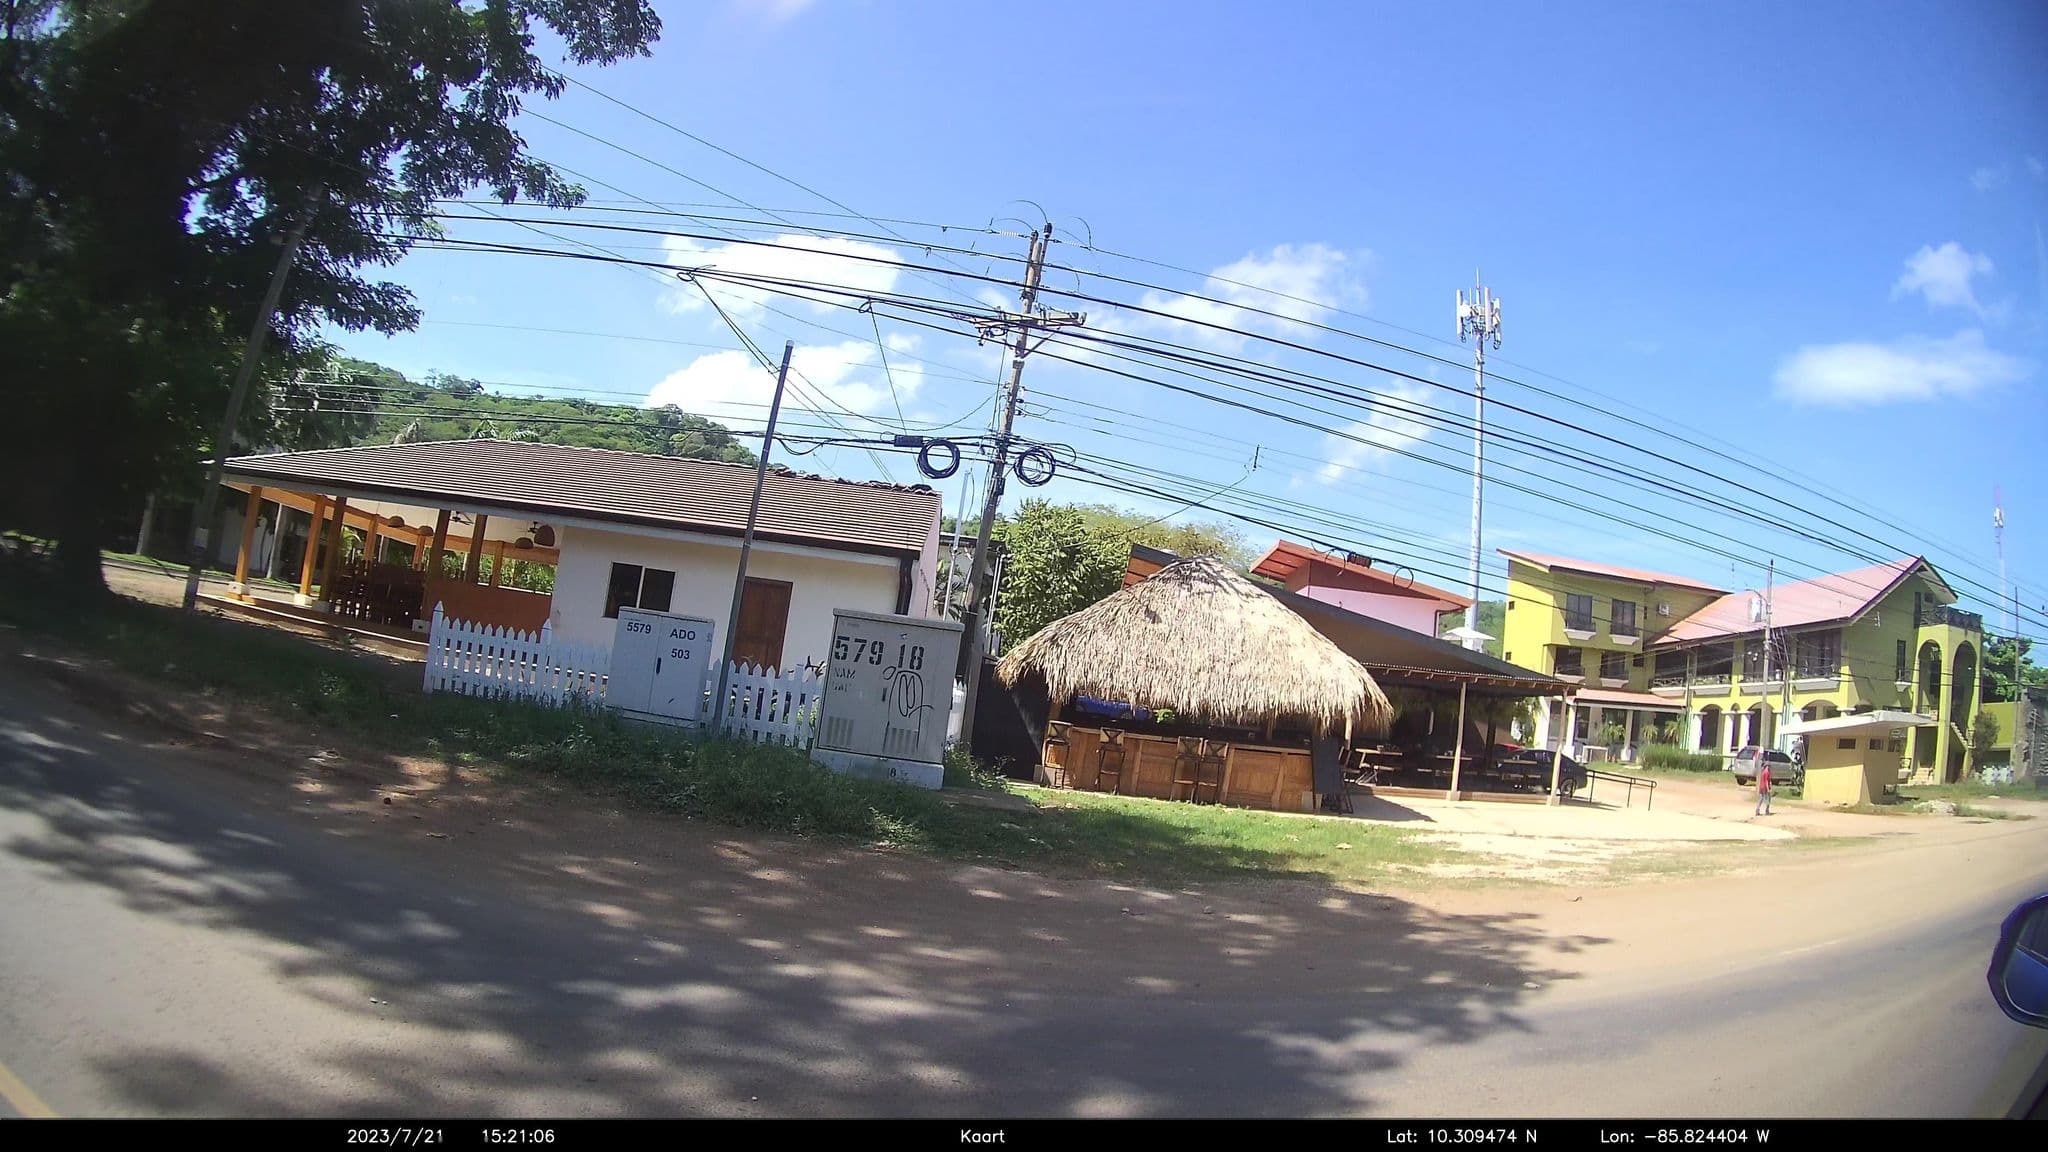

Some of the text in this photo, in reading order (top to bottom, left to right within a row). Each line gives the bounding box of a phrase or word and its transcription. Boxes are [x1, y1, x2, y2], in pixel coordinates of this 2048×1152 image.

[626, 621, 652, 634] 5579
[669, 628, 696, 641] ADO
[671, 648, 690, 660] 503
[834, 635, 925, 670] 579 18
